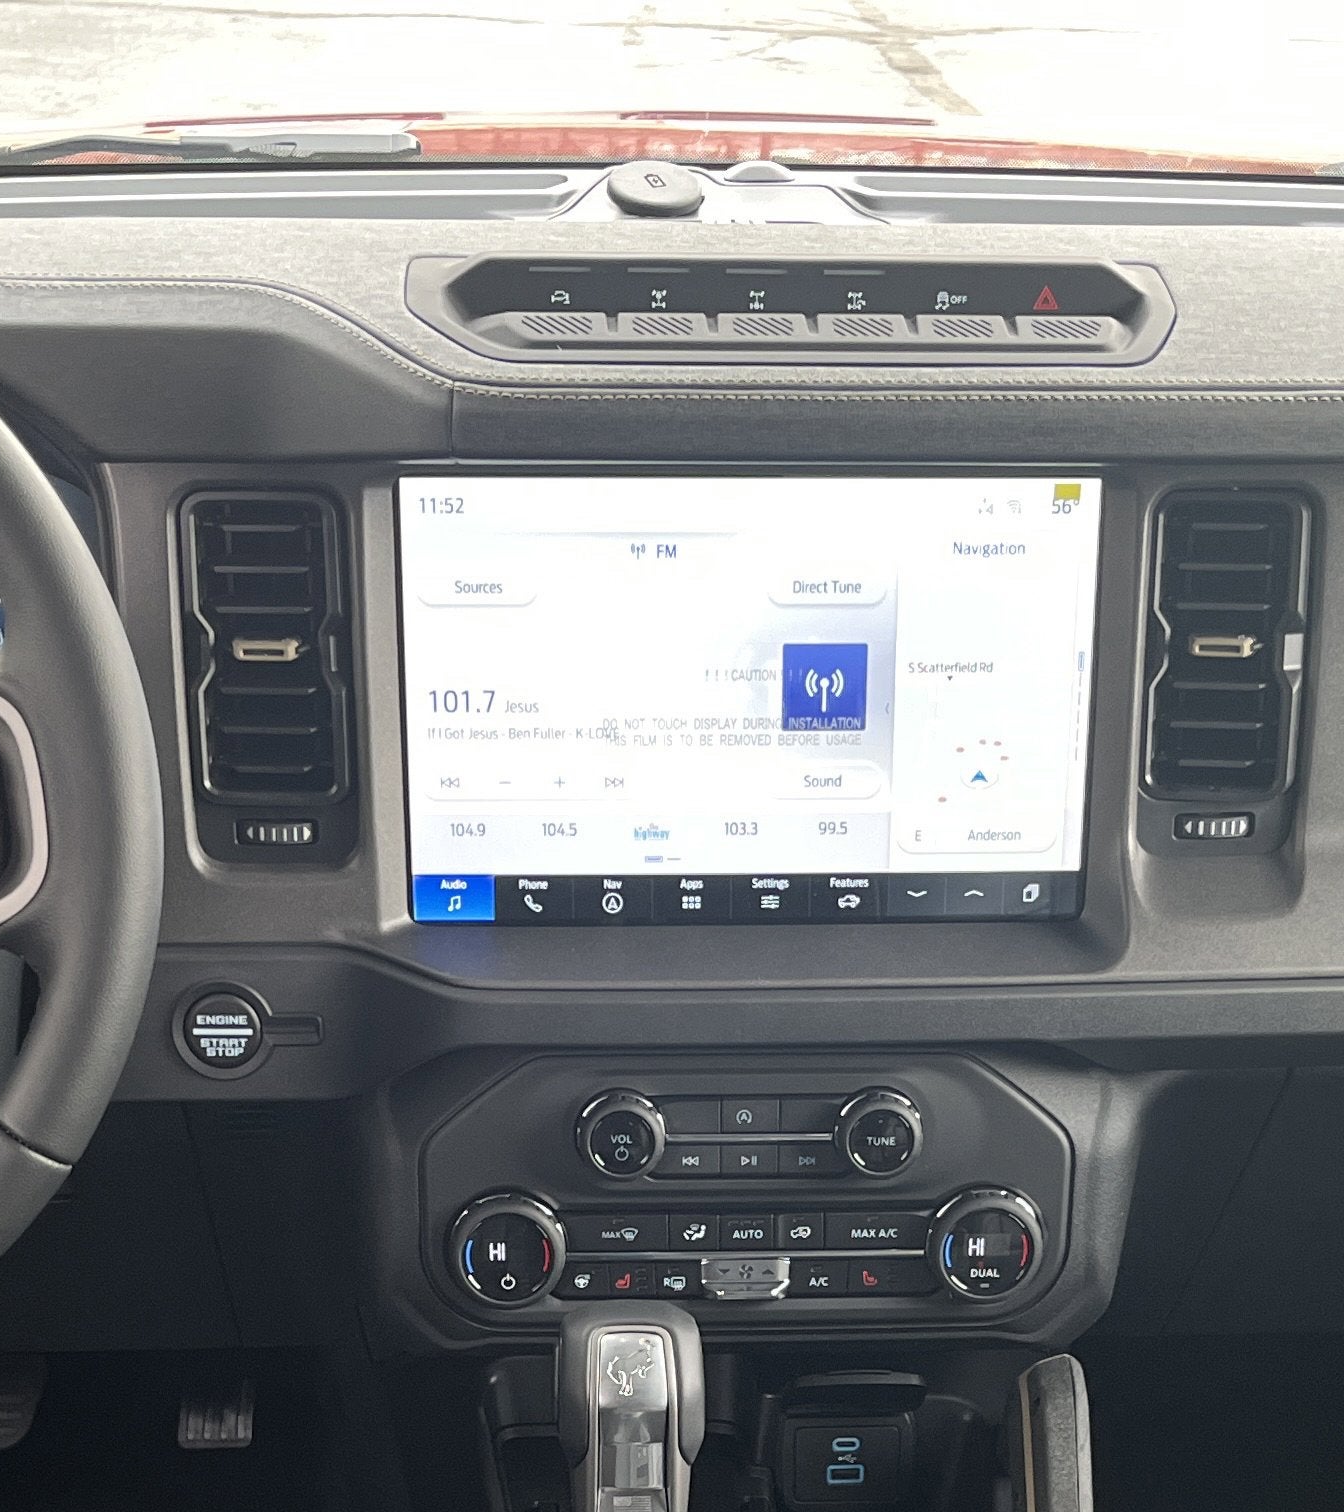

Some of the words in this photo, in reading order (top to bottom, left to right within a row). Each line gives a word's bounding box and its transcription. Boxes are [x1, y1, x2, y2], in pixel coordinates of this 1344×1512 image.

[949, 295, 968, 304] OFF
[419, 497, 464, 514] 11:52
[656, 544, 677, 558] FM
[953, 541, 1026, 558] Navigation
[454, 580, 503, 594] Sources
[792, 580, 828, 594] Direct
[832, 580, 862, 594] Tune
[908, 662, 915, 673] S
[917, 661, 978, 673] Scatterfield
[979, 661, 993, 673] Rd
[731, 668, 777, 681] CAUTION
[428, 689, 496, 713] 101.7
[504, 700, 540, 714] Jesus
[602, 717, 619, 731] DO
[624, 717, 645, 730] NOT
[652, 717, 688, 730] TOUCH
[693, 717, 736, 730] DISPLAY
[742, 717, 783, 730] DURING
[788, 717, 862, 729] INSTALLATION
[427, 727, 435, 740] If
[444, 727, 465, 740] Got
[468, 727, 499, 740] Jesus
[508, 727, 531, 740] Ben
[533, 727, 566, 740] Fuller
[604, 734, 627, 747] THIS
[633, 734, 657, 746] FILM
[663, 734, 673, 746] IS
[679, 734, 693, 746] TO
[699, 734, 713, 746] BE
[720, 734, 772, 746] REMOVED
[778, 733, 820, 746] BEFORE
[826, 733, 862, 746] USAGE
[804, 774, 842, 788] Sound
[450, 823, 486, 837] 104.9
[542, 823, 577, 837] 104.5
[634, 826, 670, 841] highway
[724, 822, 758, 836] 103.3
[818, 821, 848, 836] 99.5
[967, 828, 1021, 842] Anderson
[914, 830, 922, 842] E
[440, 879, 467, 890] Audio
[518, 879, 549, 890] Phone
[603, 879, 623, 890] Nav
[679, 879, 704, 891] Apps
[751, 877, 790, 891] Settings
[829, 876, 869, 889] Features
[196, 1014, 248, 1026] ENGINE
[200, 1038, 249, 1048] START
[206, 1047, 245, 1057] STOP
[610, 1133, 633, 1145] VOL
[866, 1136, 896, 1146] TUNE
[601, 1231, 621, 1240] MAX
[732, 1229, 764, 1240] AUTO
[850, 1228, 876, 1239] MAX
[878, 1227, 898, 1239] A/C
[489, 1242, 506, 1262] HI
[968, 1237, 985, 1257] HI
[970, 1268, 1000, 1279] DUAL
[809, 1276, 829, 1288] A/C
